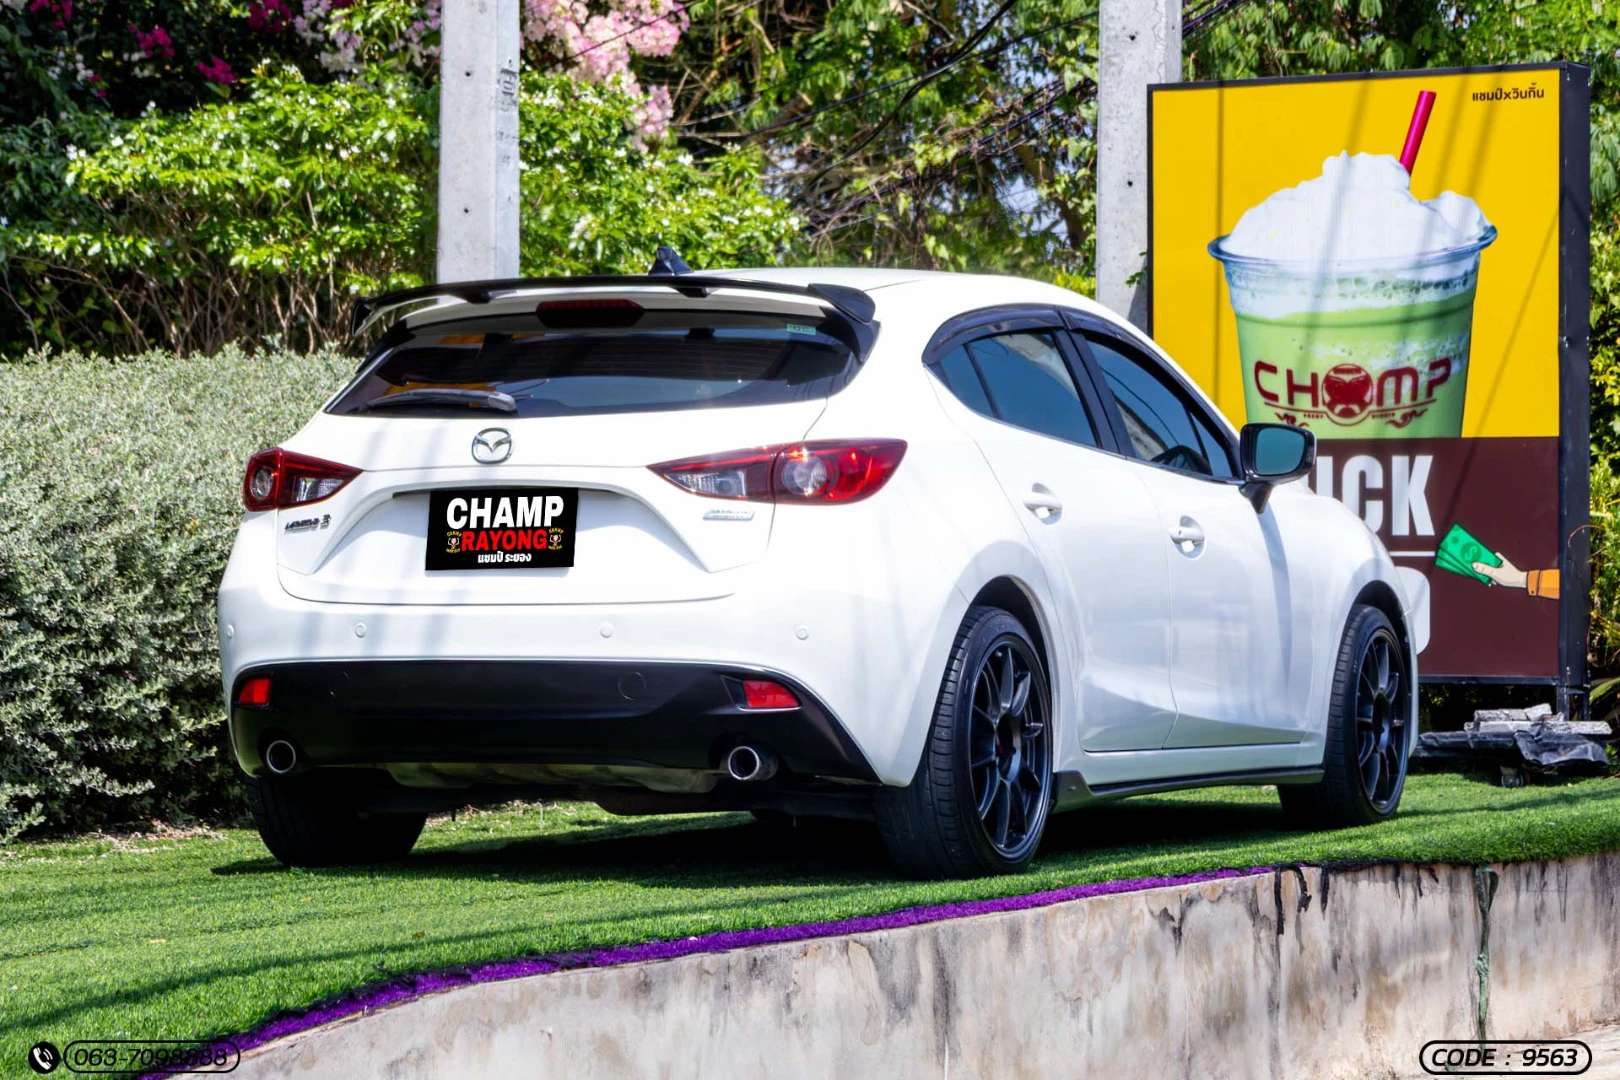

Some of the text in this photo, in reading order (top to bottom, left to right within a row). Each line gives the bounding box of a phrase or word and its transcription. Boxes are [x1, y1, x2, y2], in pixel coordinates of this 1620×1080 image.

[1302, 455, 1435, 536] ICK
[446, 496, 564, 529] CHAMP
[461, 529, 547, 551] RAYONG
[504, 553, 532, 563] ระยอง
